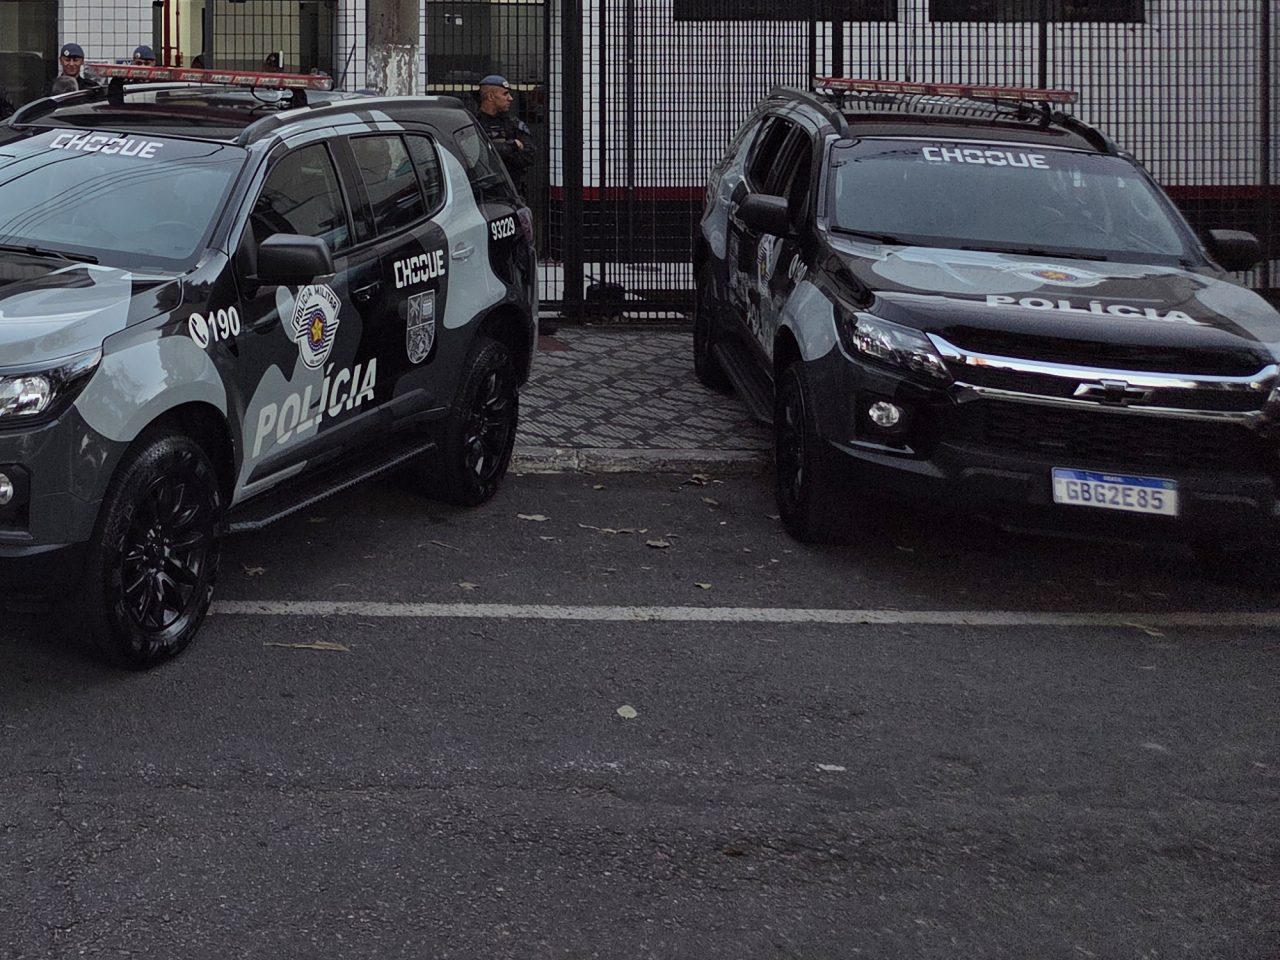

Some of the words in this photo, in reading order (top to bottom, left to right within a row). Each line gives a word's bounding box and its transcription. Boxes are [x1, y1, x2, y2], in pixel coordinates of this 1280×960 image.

[49, 133, 164, 159] CHOQUE
[491, 217, 516, 241] 93229
[393, 249, 446, 289] CHOQUE
[207, 305, 241, 342] 190
[985, 294, 1212, 326] POLÍCIA
[252, 357, 378, 459] POLÍCIA
[1065, 480, 1164, 510] GBG2E85
